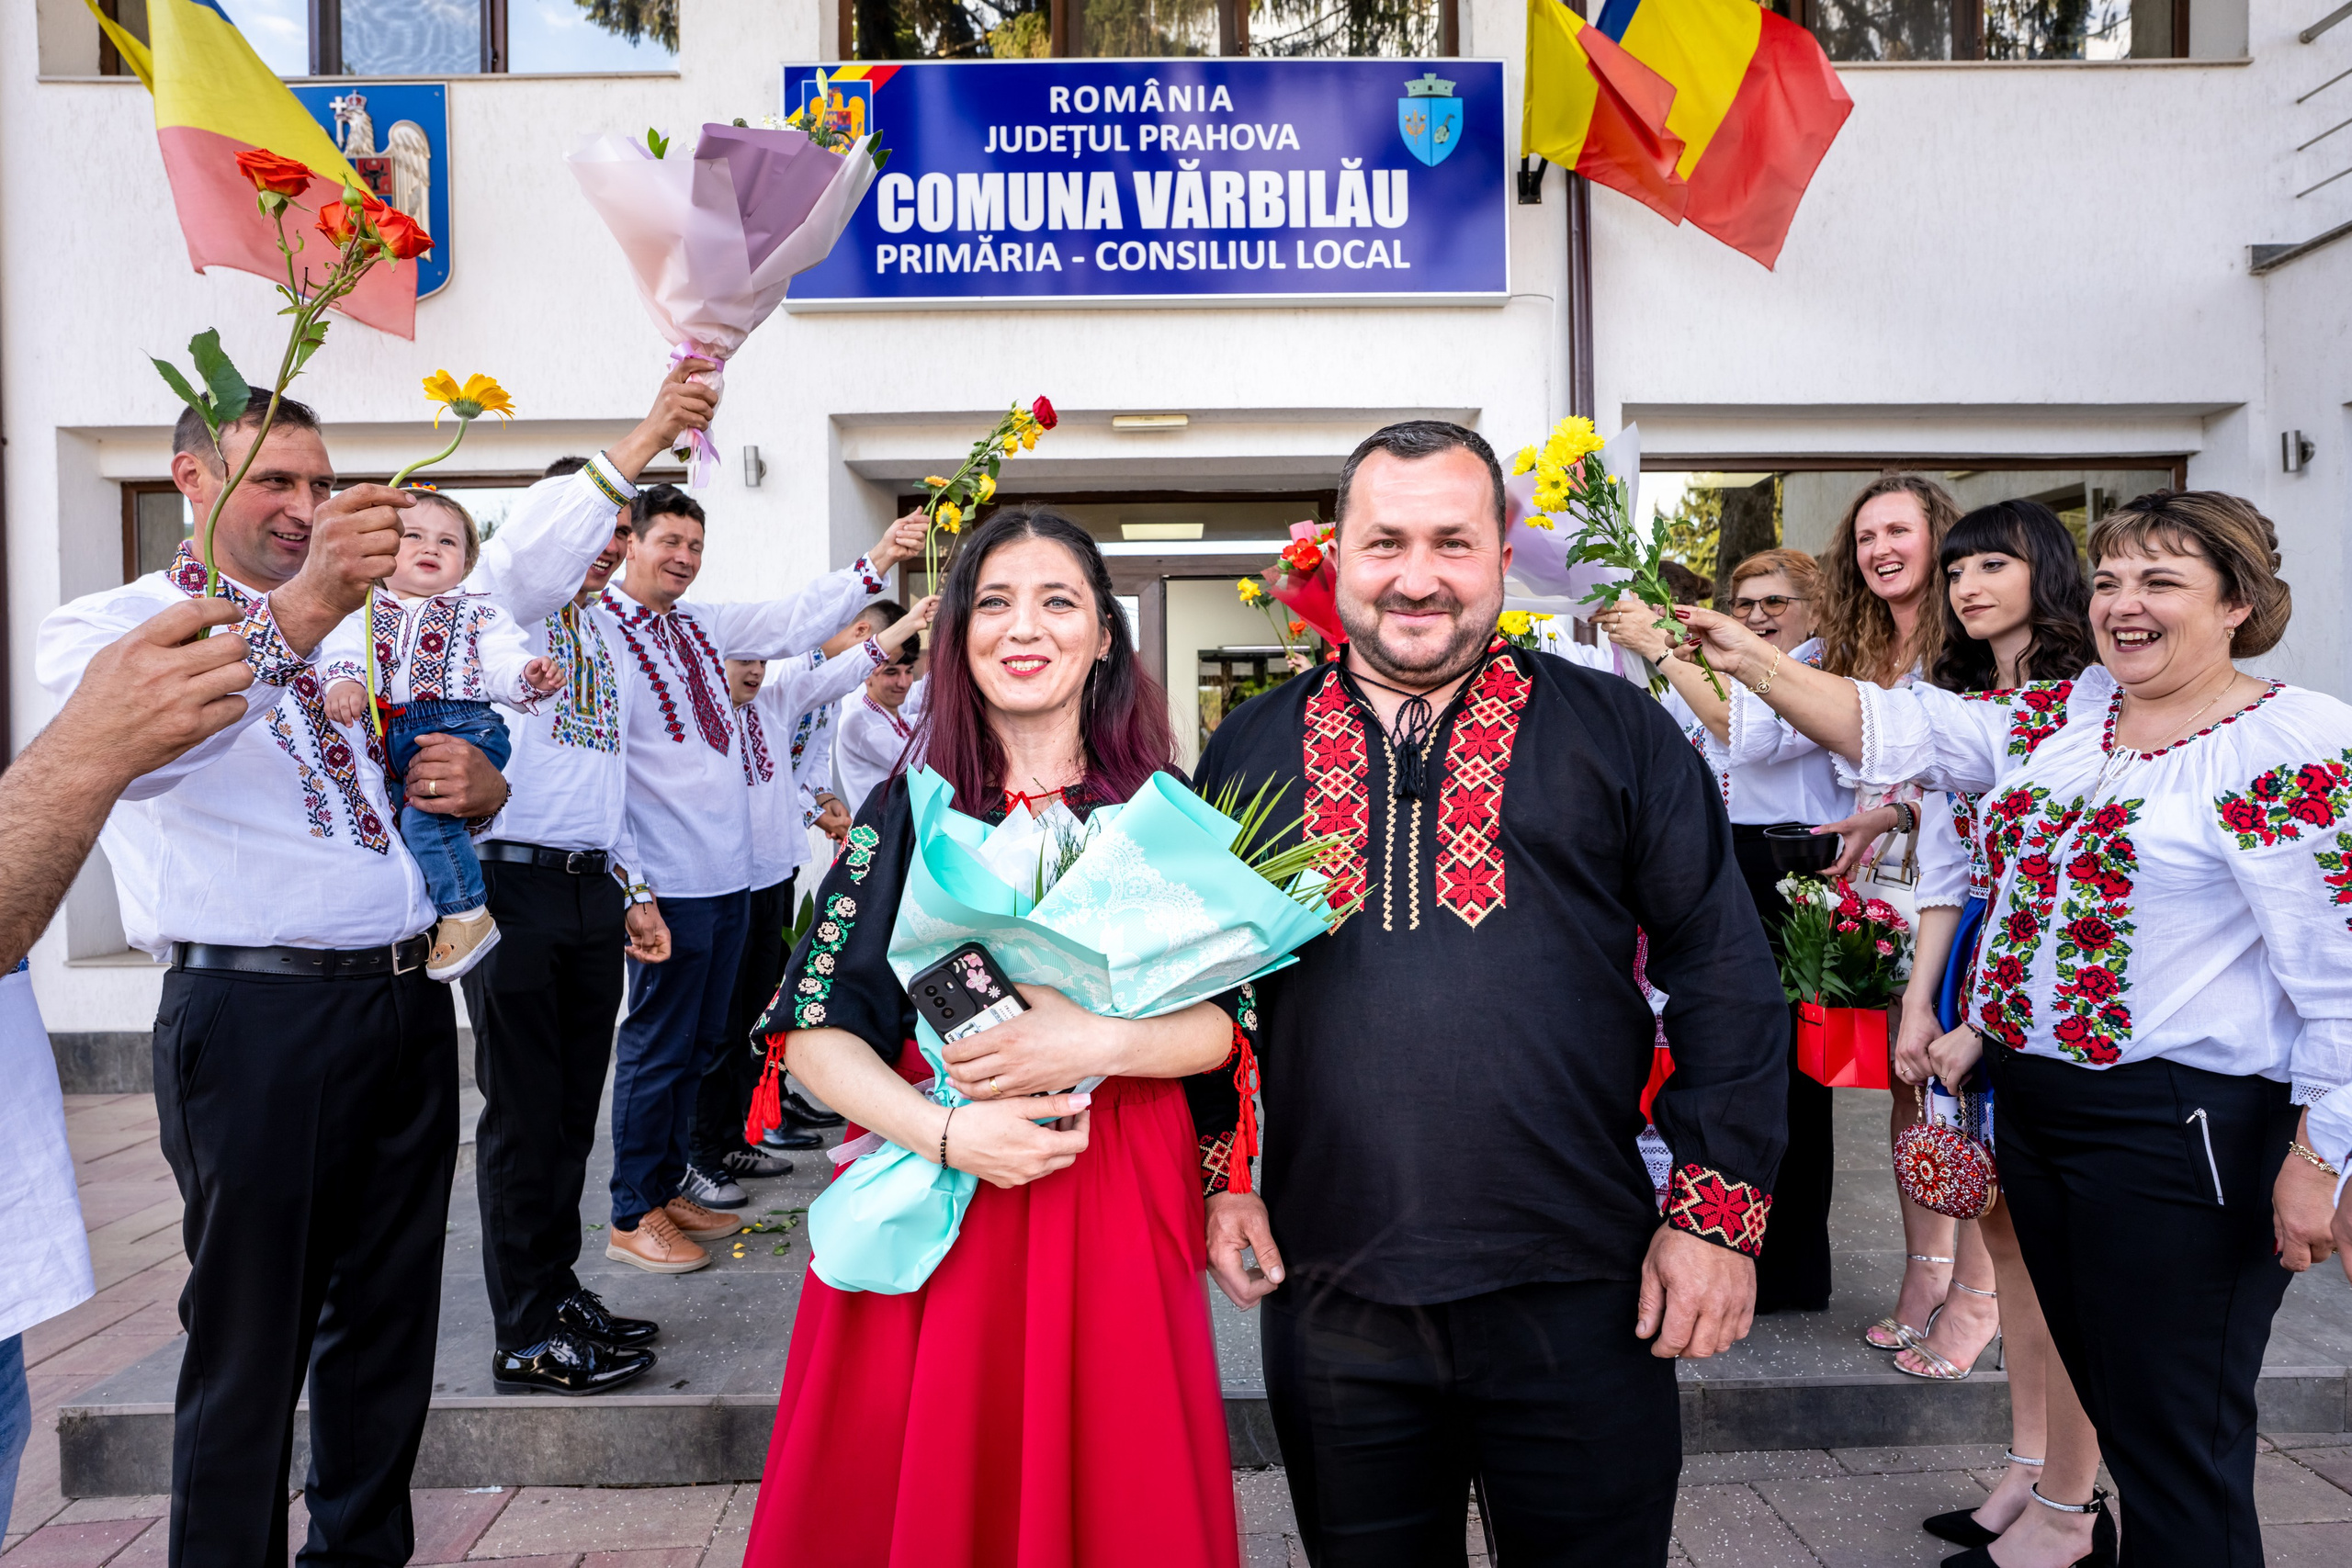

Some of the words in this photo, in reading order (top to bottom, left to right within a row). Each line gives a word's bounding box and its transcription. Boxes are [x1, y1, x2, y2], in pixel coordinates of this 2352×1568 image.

[1049, 77, 1234, 113] ROMÂNIA
[983, 124, 1130, 160] JUDEȚUL
[1139, 123, 1301, 152] PRAHOVA
[876, 171, 1125, 233] COMUNA
[1132, 157, 1409, 230] VĂRBILĂU
[876, 234, 1064, 274] PRIMĂRIA
[1094, 240, 1287, 271] CONSILIUL
[1296, 239, 1411, 270] LOCAL
